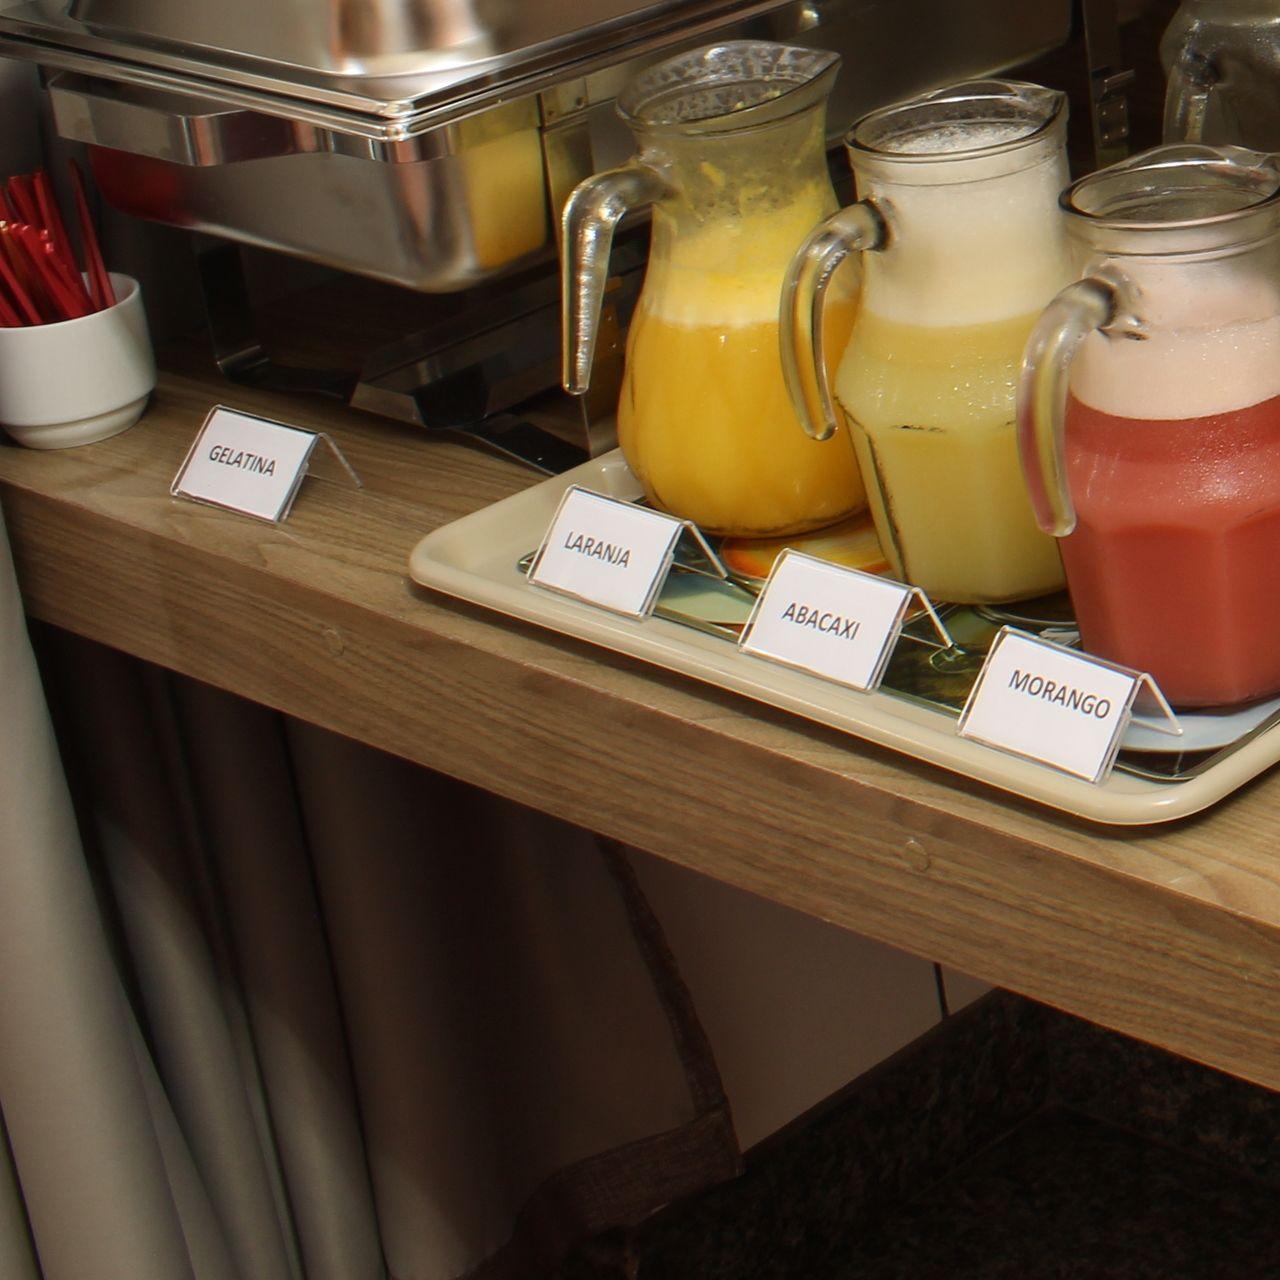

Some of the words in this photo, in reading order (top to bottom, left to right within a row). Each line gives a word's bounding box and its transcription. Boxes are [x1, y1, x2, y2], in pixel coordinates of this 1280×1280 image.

[209, 445, 277, 477] GELATINA
[564, 531, 631, 568] LARANJA
[781, 602, 861, 640] ABACAXI
[1008, 670, 1111, 719] MORANGO
